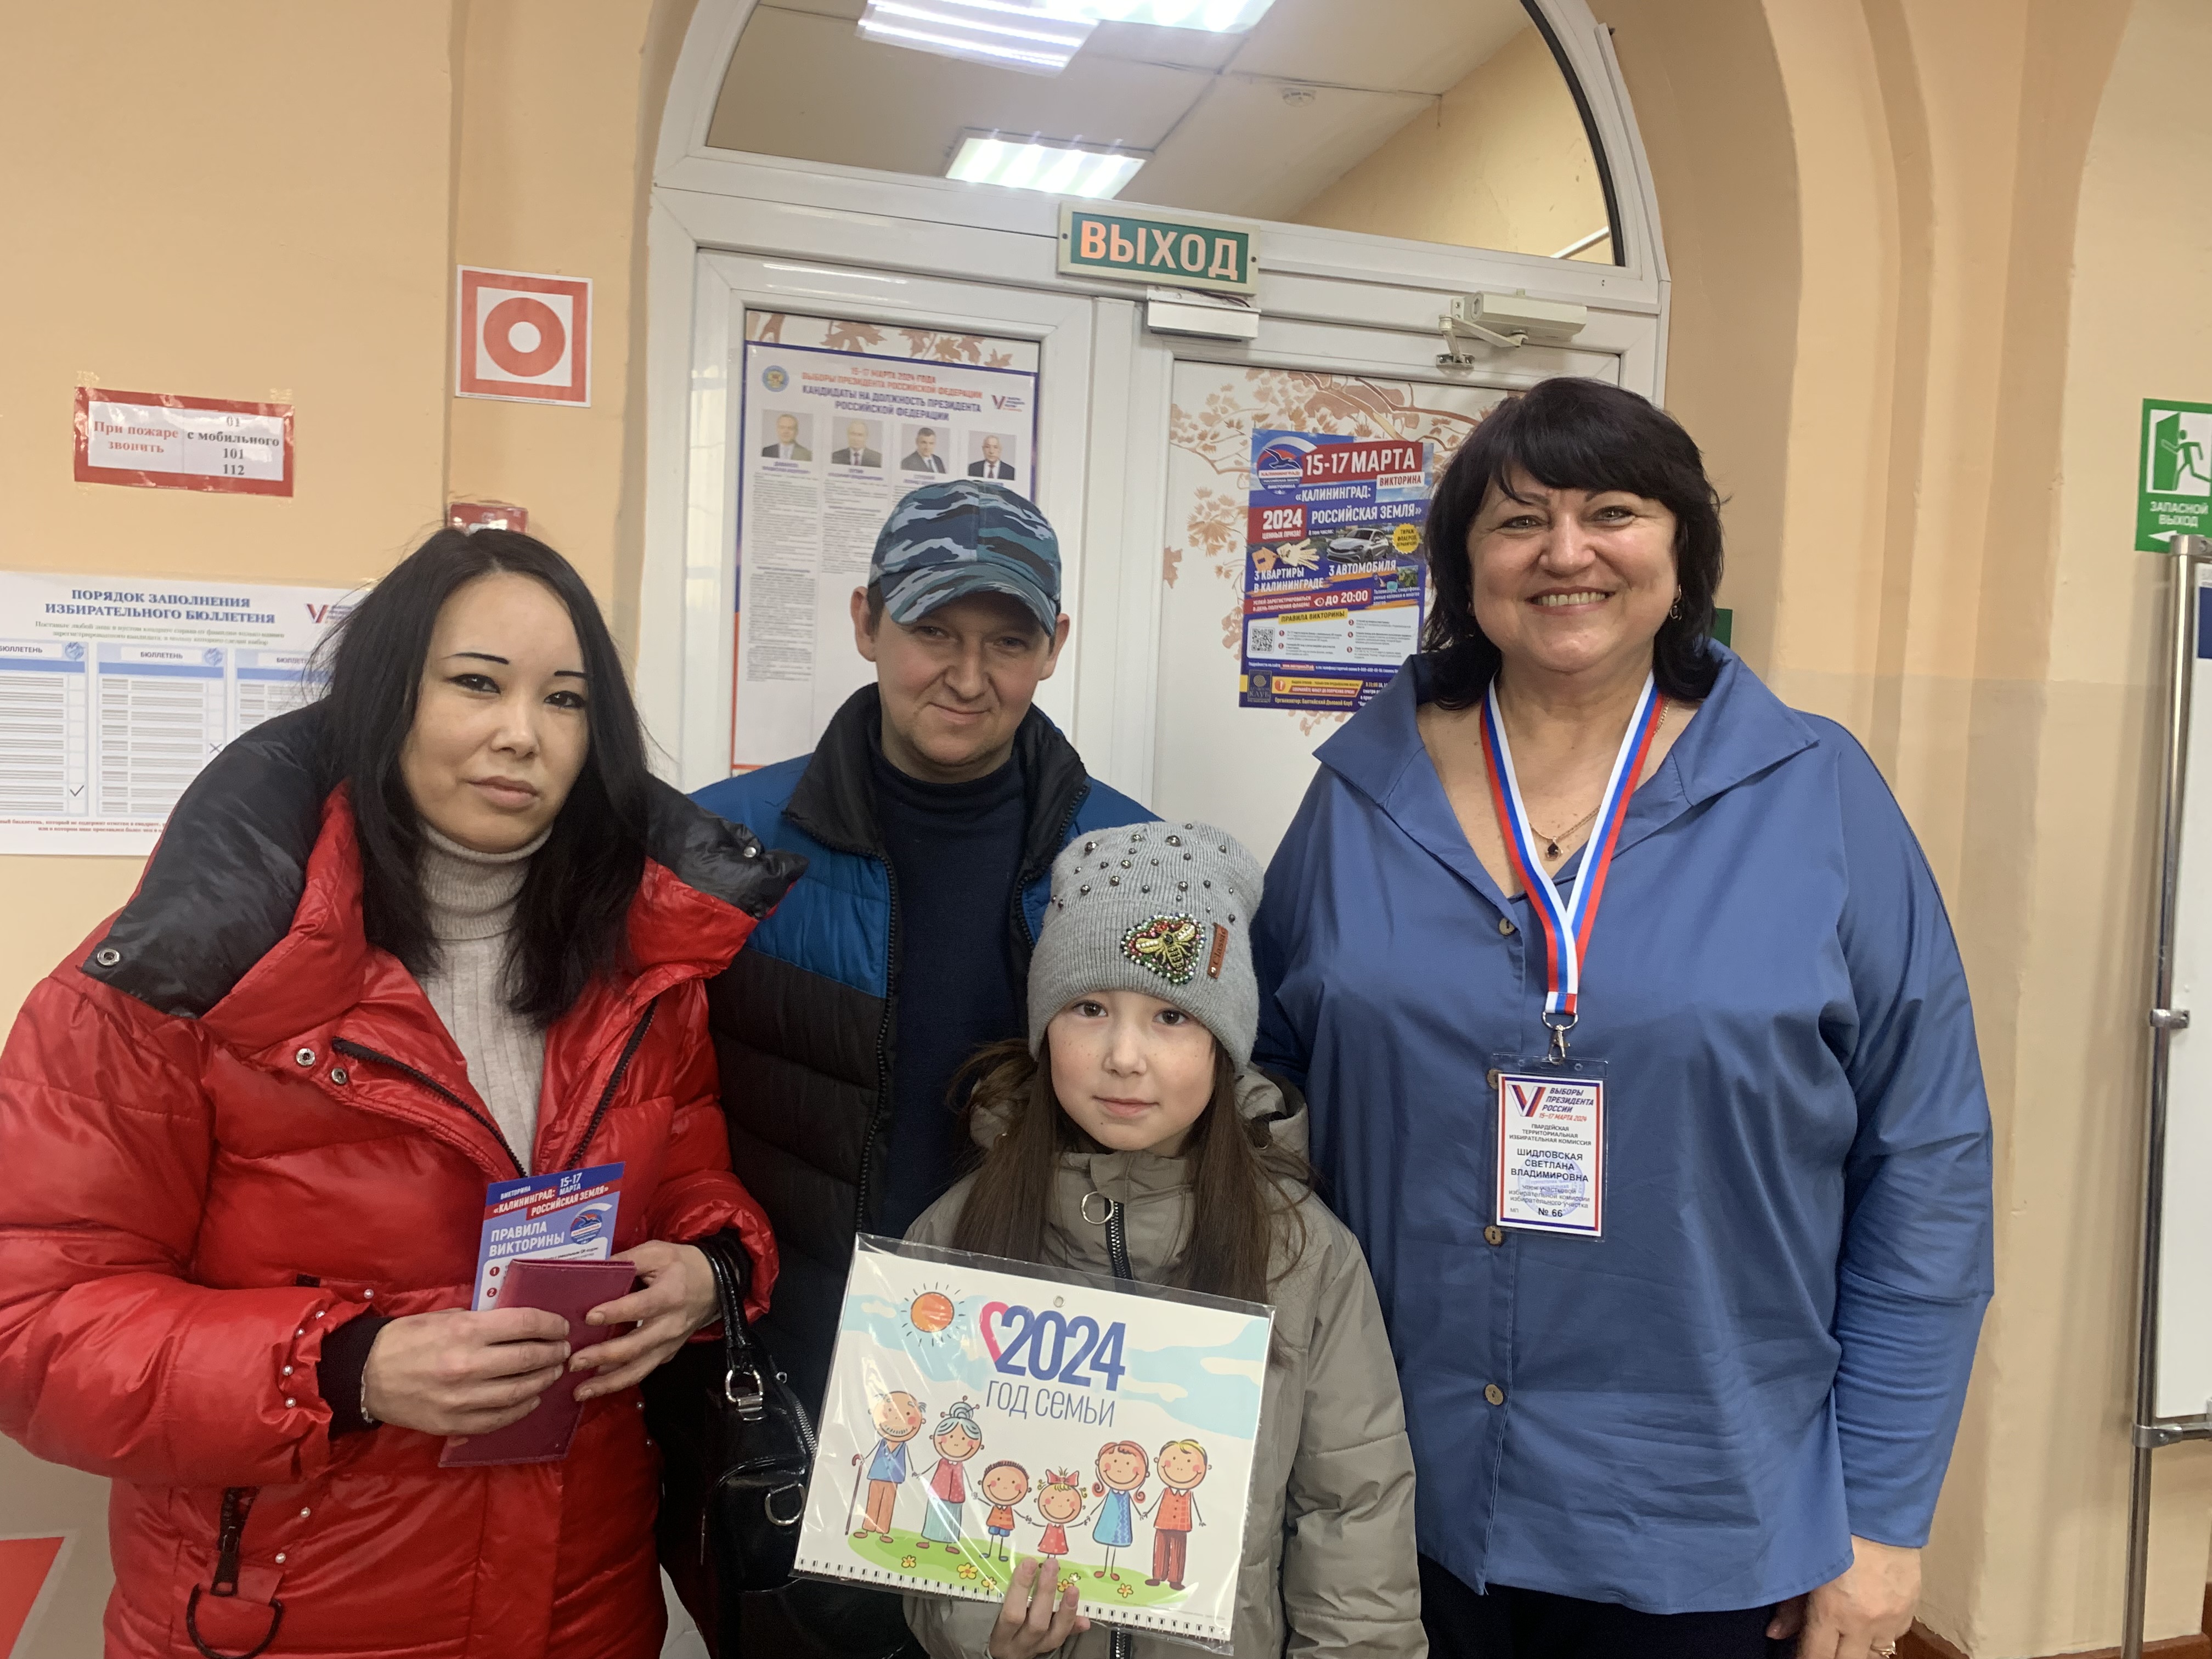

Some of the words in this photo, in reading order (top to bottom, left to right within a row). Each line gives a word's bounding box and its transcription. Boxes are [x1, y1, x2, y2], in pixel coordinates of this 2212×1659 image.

[1080, 220, 1238, 281] ВЫХОД
[802, 372, 835, 382] ВЫБОРЫ
[837, 376, 885, 387] ПРЕЗИДЕНТА
[887, 381, 935, 393] РОССИЙСКОЙ
[938, 387, 983, 399] ФЕДЕРАЦИИ
[917, 375, 935, 383] ГОДА
[803, 385, 857, 399] КАНДИДАТЫ
[859, 391, 870, 399] НА
[872, 392, 926, 406] ДОЛЖНОСТЬ
[927, 399, 981, 412] ПРЕЗИДЕНТА
[835, 400, 894, 414] РОССИЙСКОЙ
[896, 408, 949, 421] ФЕДЕРАЦИИ
[227, 416, 240, 427] 01
[94, 421, 123, 435] При
[128, 427, 179, 440] пожаре
[187, 431, 194, 439] с
[198, 430, 279, 447] мобильного
[108, 441, 164, 453] звонить
[223, 448, 244, 460] 101
[1306, 452, 1350, 476] 15-17
[1351, 447, 1415, 474] МАРТА
[223, 464, 245, 476] 112
[1379, 474, 1422, 487] ВИКТОРИНА
[1295, 484, 1372, 503] «КАЛИНИНГРАД:
[1311, 505, 1377, 524] РОССИЙСКАЯ
[1380, 503, 1422, 519] ЗЕМЛЯ»
[2149, 501, 2209, 515] ЗАПАСНОЙ
[1262, 508, 1303, 531] 2024
[2158, 514, 2199, 528] ВЫХОД
[1254, 570, 1260, 582] 3
[1261, 567, 1305, 580] КВАРТИРЫ
[1328, 565, 1334, 577] 3
[1335, 560, 1397, 576] АВТОМОБИЛЯ
[1254, 583, 1260, 594] В
[1261, 578, 1325, 592] КАЛИНИНГРАДЕ
[71, 589, 144, 605] ПОРЯДОК
[149, 593, 250, 608] ЗАПОЛНЕНИЯ
[1341, 590, 1368, 603] 20:00
[44, 603, 182, 620] ИЗБИРАТЕЛЬНОГО
[187, 608, 275, 624] БЮЛЛЕТЕНЯ
[1281, 614, 1308, 623] ПРАВИЛА
[1309, 611, 1345, 620] ВИКТОРИНЫ
[140, 651, 183, 659] БЮЛЛЕТЕНЬ
[1549, 1087, 1584, 1096] ВЫБОРЫ
[1545, 1096, 1594, 1106] ПРЕЗИДЕНТА
[1542, 1104, 1573, 1113] РОССИИ
[1522, 1129, 1579, 1138] ТЕРРИТОРИАЛЬНАЯ
[1531, 1123, 1570, 1132] ГВАРДЕЙСКАЯ
[1509, 1134, 1558, 1143] ИЗБИРАТЕЛЬНАЯ
[1517, 1148, 1583, 1161] ШИДЛОВСКАЯ
[1525, 1159, 1575, 1171] СВЕТЛАНА
[560, 1172, 583, 1187] 15-17
[1511, 1168, 1589, 1182] ВЛАДИМИРОВНА
[500, 1185, 531, 1200] ВИКТОРИНА
[559, 1183, 582, 1196] МАРТА
[1509, 1189, 1558, 1199] избирательной
[493, 1188, 556, 1214] «КАЛИНИНГРАД:
[531, 1194, 579, 1216] РОССИЙСКАЯ
[579, 1186, 609, 1201] ЗЕМЛЯ»
[1510, 1196, 1562, 1206] избирательного
[1538, 1207, 1549, 1216] №
[1551, 1209, 1563, 1217] 66
[490, 1221, 548, 1243] ПРАВИЛА
[488, 1231, 565, 1257] ВИКТОРИНЫ
[995, 1304, 1126, 1391] 2024
